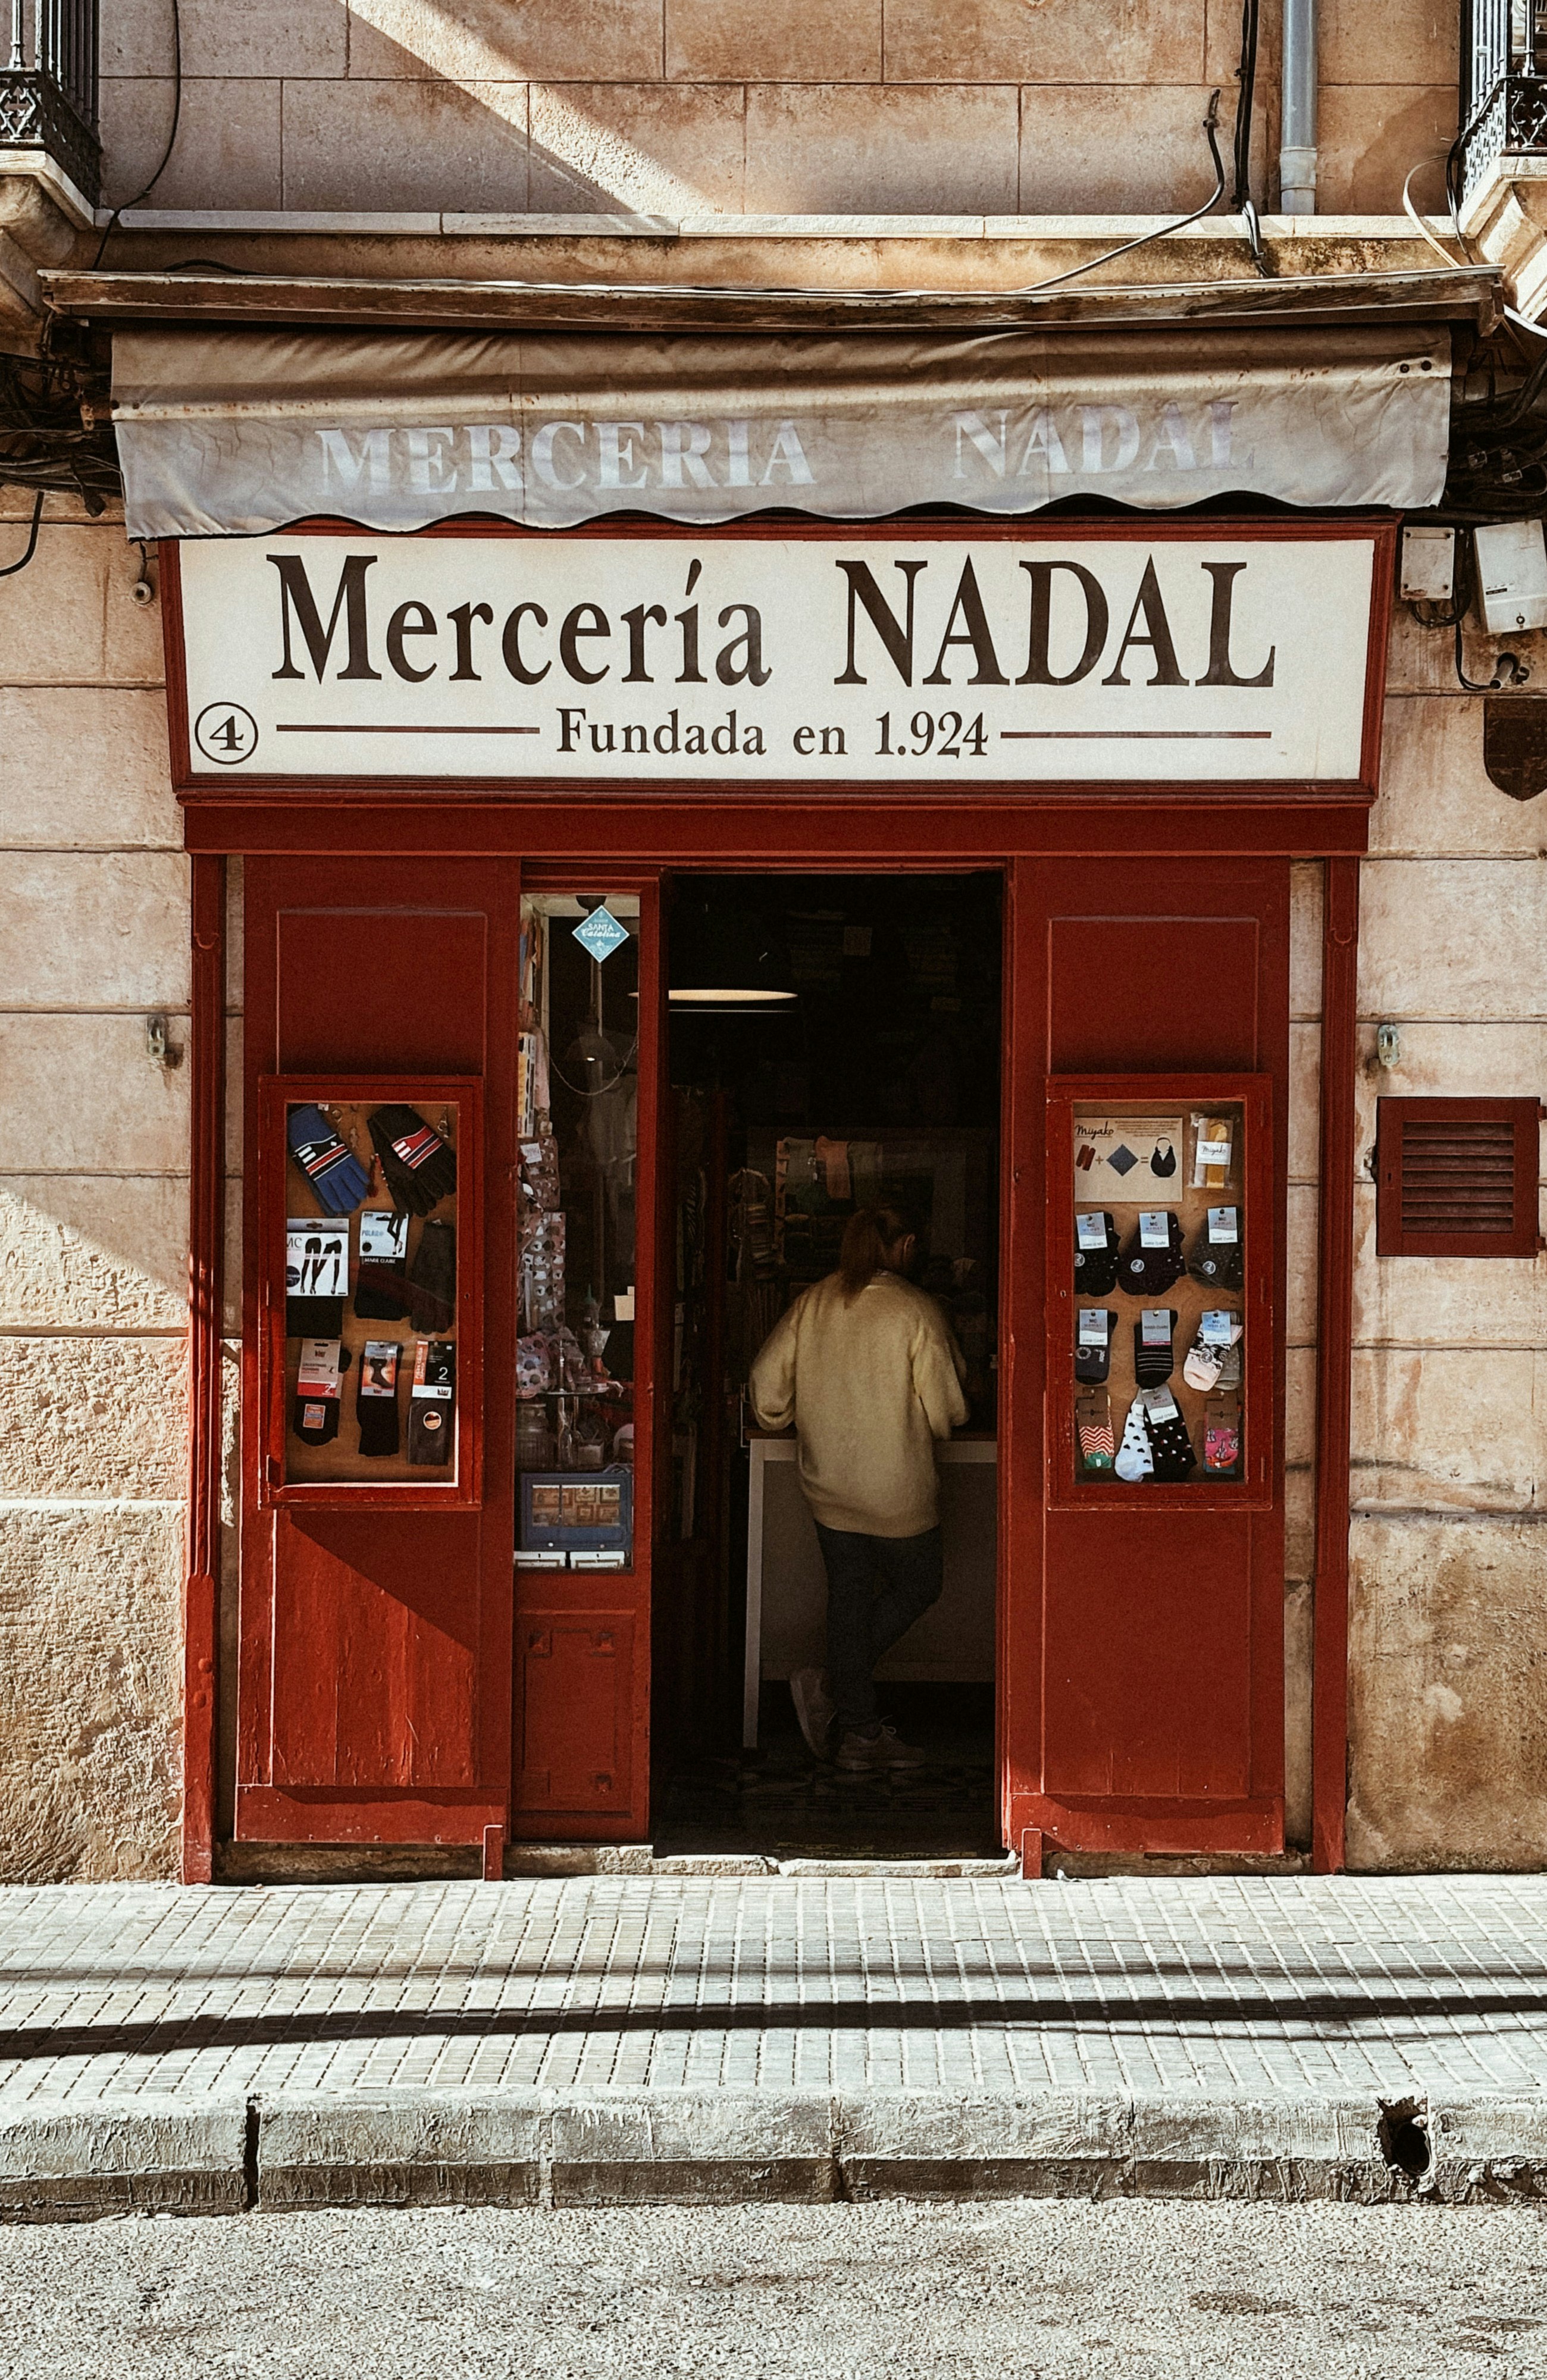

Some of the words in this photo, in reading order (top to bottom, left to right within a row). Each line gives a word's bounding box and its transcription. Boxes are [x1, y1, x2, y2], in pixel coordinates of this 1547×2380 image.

[315, 421, 817, 496] MERCERIA
[951, 401, 1254, 480] NADAL
[266, 553, 773, 687] Mercería
[834, 553, 1276, 687] NADAL
[209, 716, 244, 751] 4
[556, 707, 767, 756] Fundada
[793, 721, 848, 756] en
[874, 711, 989, 759] 1.924
[588, 923, 614, 932] SANTA
[438, 1367, 448, 1380] 2
